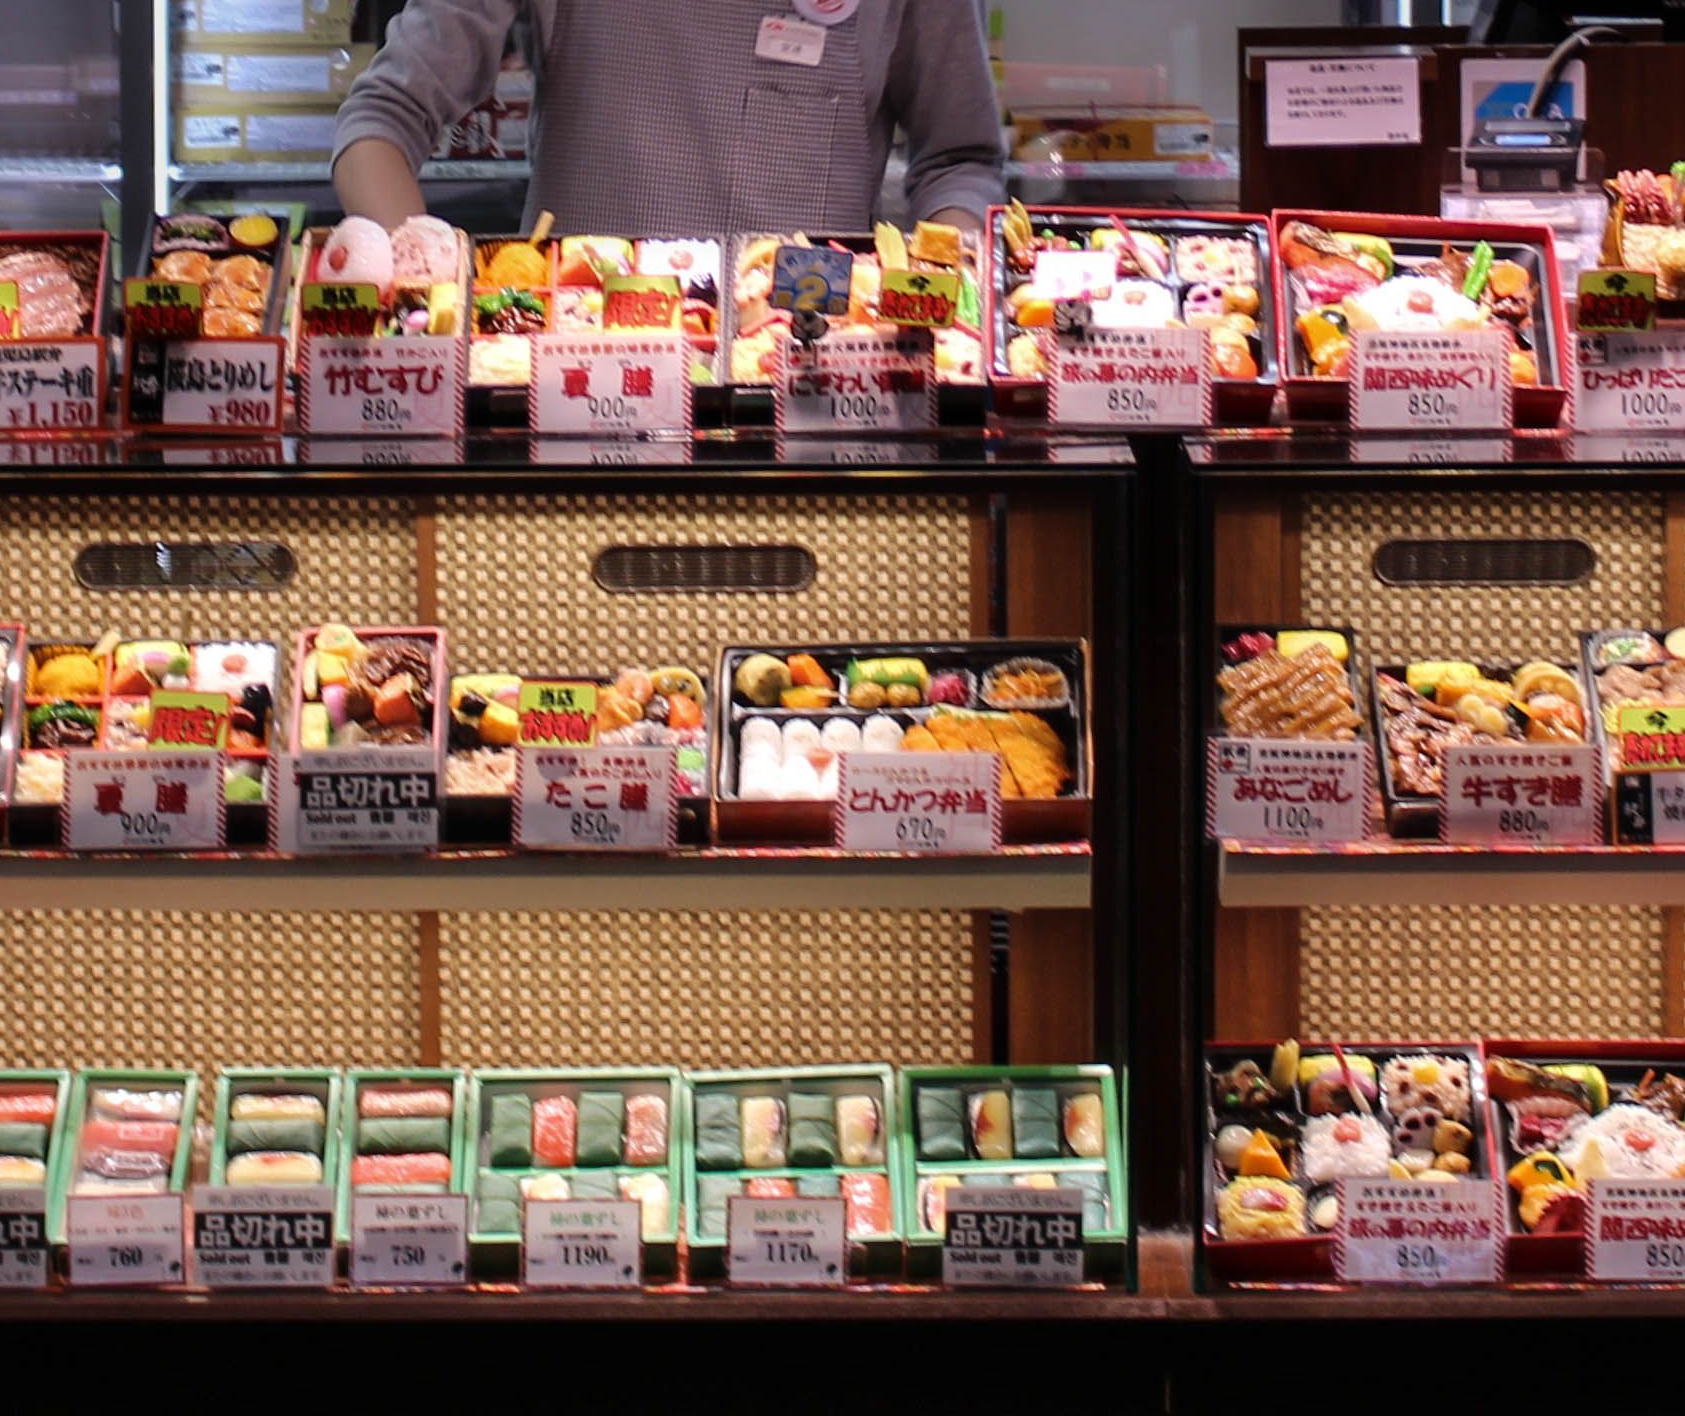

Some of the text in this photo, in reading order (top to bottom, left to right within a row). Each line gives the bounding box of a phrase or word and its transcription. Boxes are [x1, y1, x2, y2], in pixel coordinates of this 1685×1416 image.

[324, 364, 444, 396] 竹むすび
[8, 400, 93, 427] ¥1,150
[208, 399, 270, 426] ¥980
[540, 688, 574, 706] 当店
[306, 778, 430, 807] 品切れ中
[849, 788, 986, 814] とんかつ弁当
[1233, 777, 1353, 803] あなごめし
[1461, 774, 1583, 808] 牛すき膳
[199, 1215, 326, 1247] 品切れ中
[950, 1215, 1077, 1247] 品切れ中
